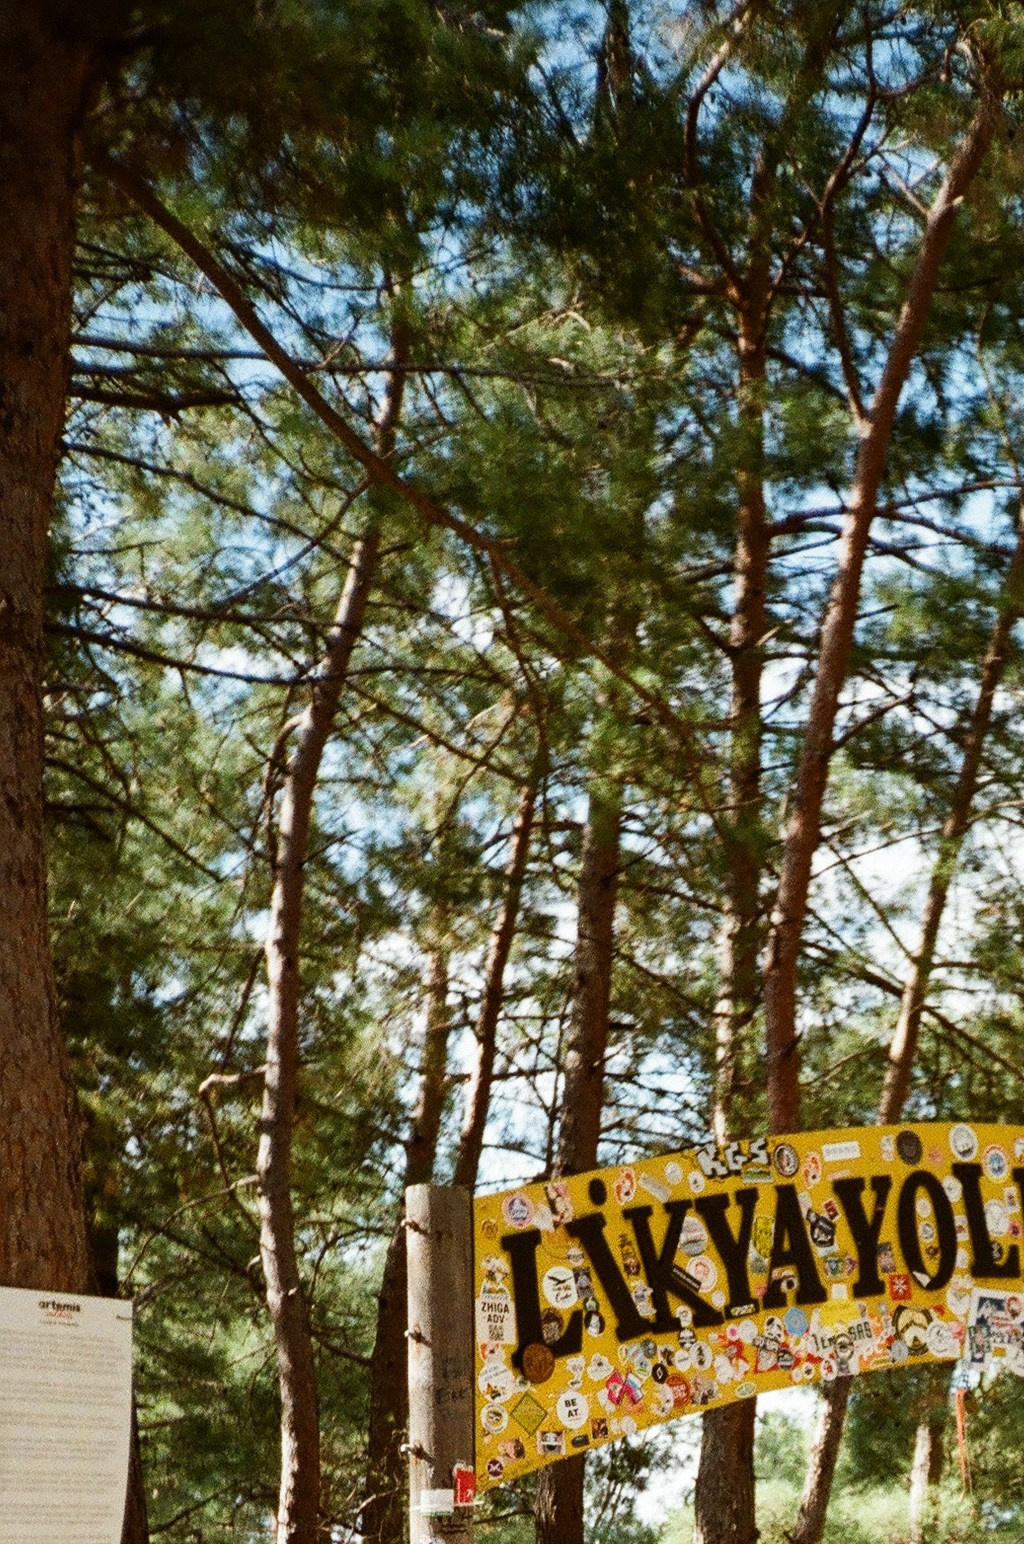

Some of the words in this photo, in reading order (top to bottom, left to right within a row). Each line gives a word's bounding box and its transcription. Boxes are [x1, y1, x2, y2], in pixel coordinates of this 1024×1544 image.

[38, 1300, 80, 1312] artemis
[564, 1397, 577, 1408] BE
[567, 1408, 579, 1418] AT
